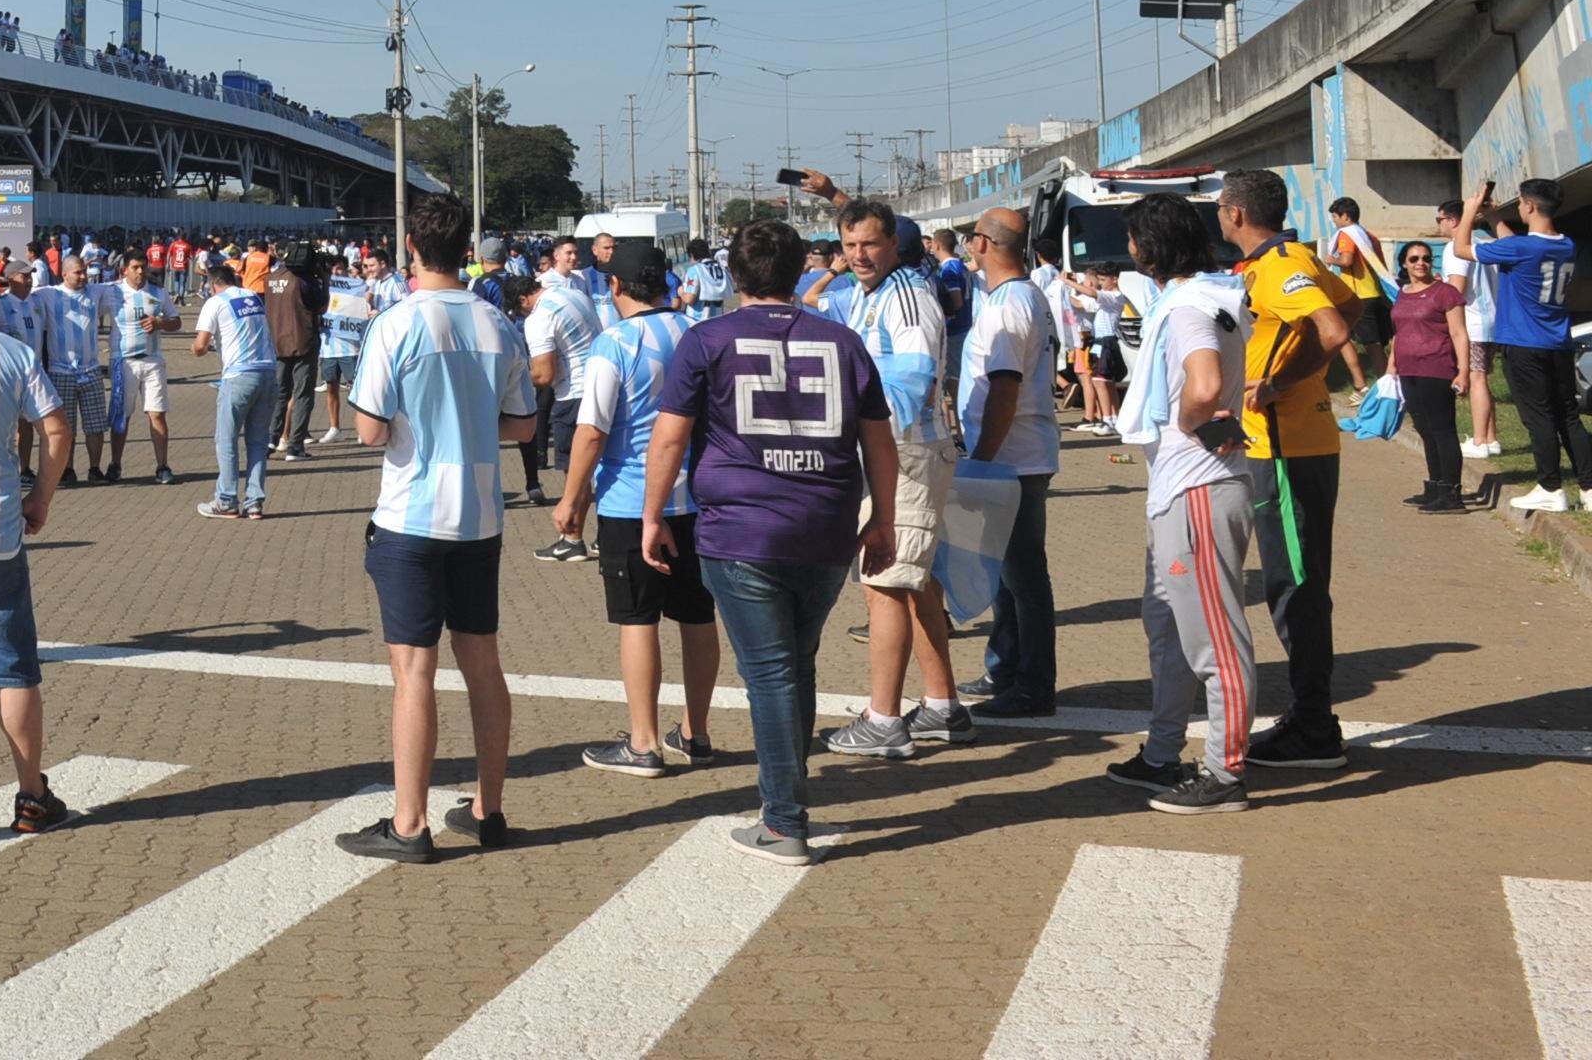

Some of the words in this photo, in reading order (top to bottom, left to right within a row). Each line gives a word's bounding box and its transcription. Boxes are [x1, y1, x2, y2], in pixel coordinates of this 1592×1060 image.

[16, 180, 30, 193] 06
[12, 205, 23, 215] 05
[278, 279, 289, 287] TV
[23, 316, 34, 329] 10
[734, 338, 843, 438] 23
[762, 448, 825, 472] PONZIO
